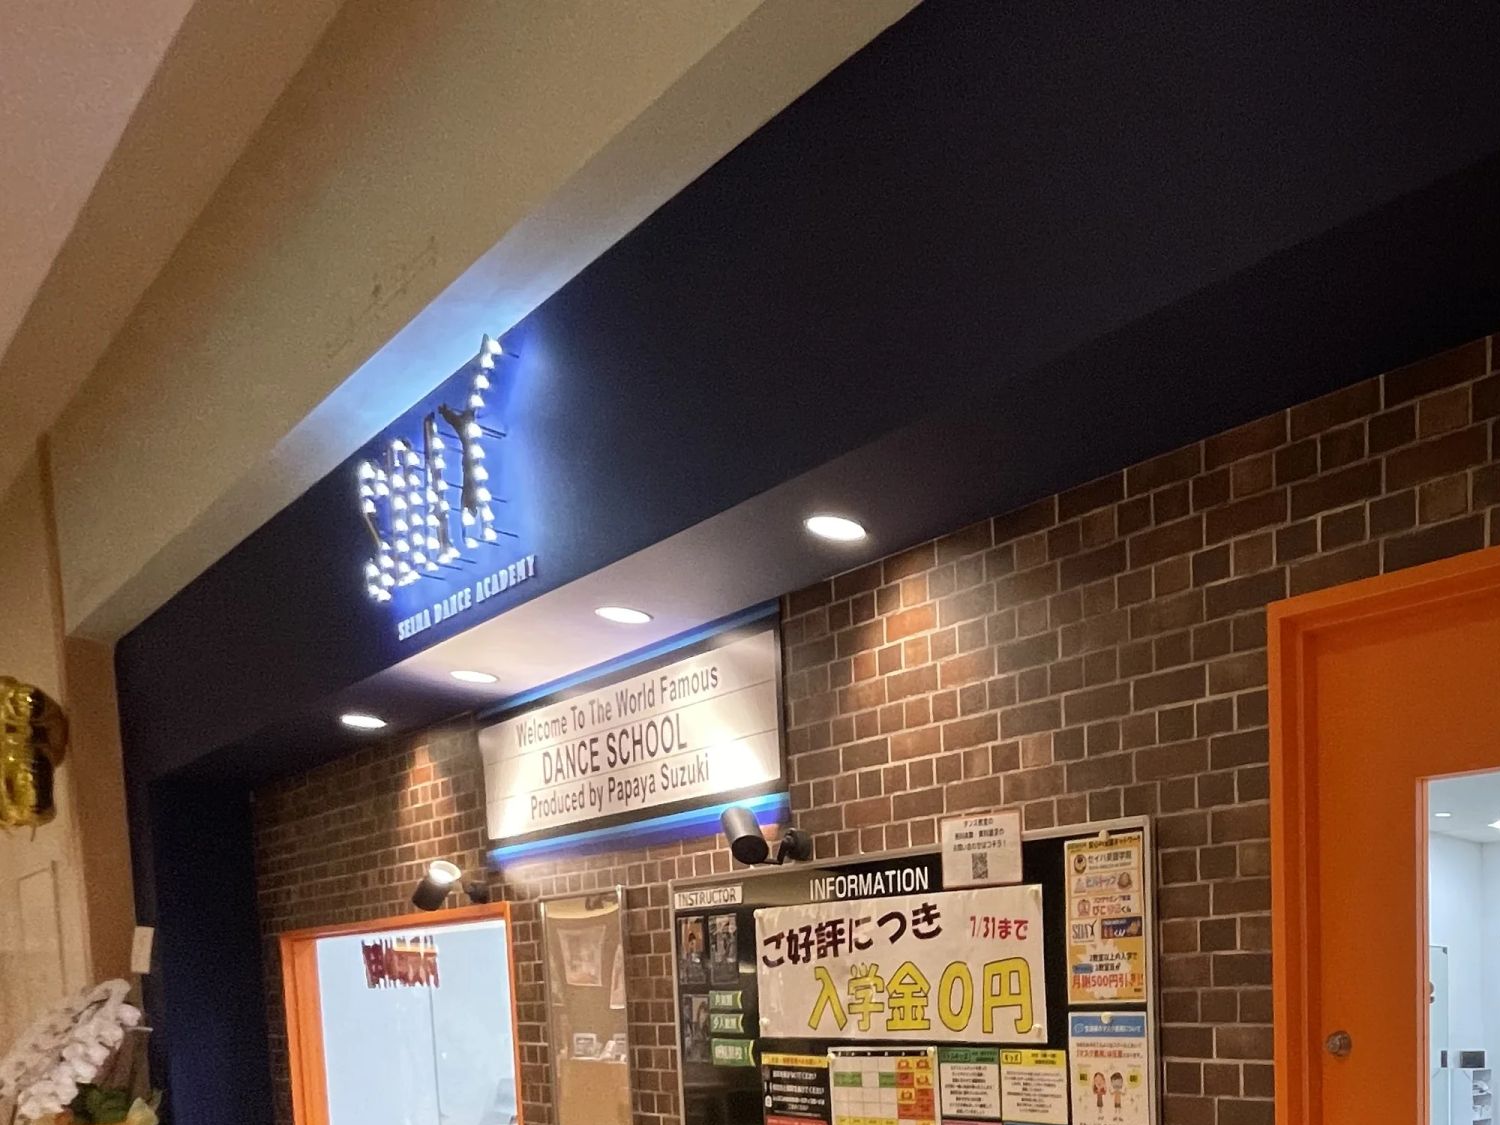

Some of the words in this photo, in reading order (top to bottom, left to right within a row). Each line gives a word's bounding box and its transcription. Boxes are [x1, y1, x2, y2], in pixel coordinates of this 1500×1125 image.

[397, 608, 431, 641] SEIHA
[433, 587, 472, 624] DANCE
[476, 553, 537, 603] ACADEMY
[516, 713, 568, 748] Welcome
[570, 705, 586, 730] To
[588, 698, 613, 726] The
[614, 679, 656, 718] World
[660, 665, 719, 702] Famous
[542, 736, 601, 785] DANCE
[605, 712, 689, 769] SCHOOL
[530, 786, 586, 820] Produced
[588, 780, 604, 812] by
[607, 773, 656, 807] Papaya
[660, 752, 710, 791] Suzuki
[678, 890, 737, 907] INSTRUCTOR
[809, 866, 929, 900] INFORMATION
[761, 902, 943, 968] ご好評につき
[969, 915, 1029, 941] 7/31まで
[808, 957, 1034, 1035] 入学金0円
